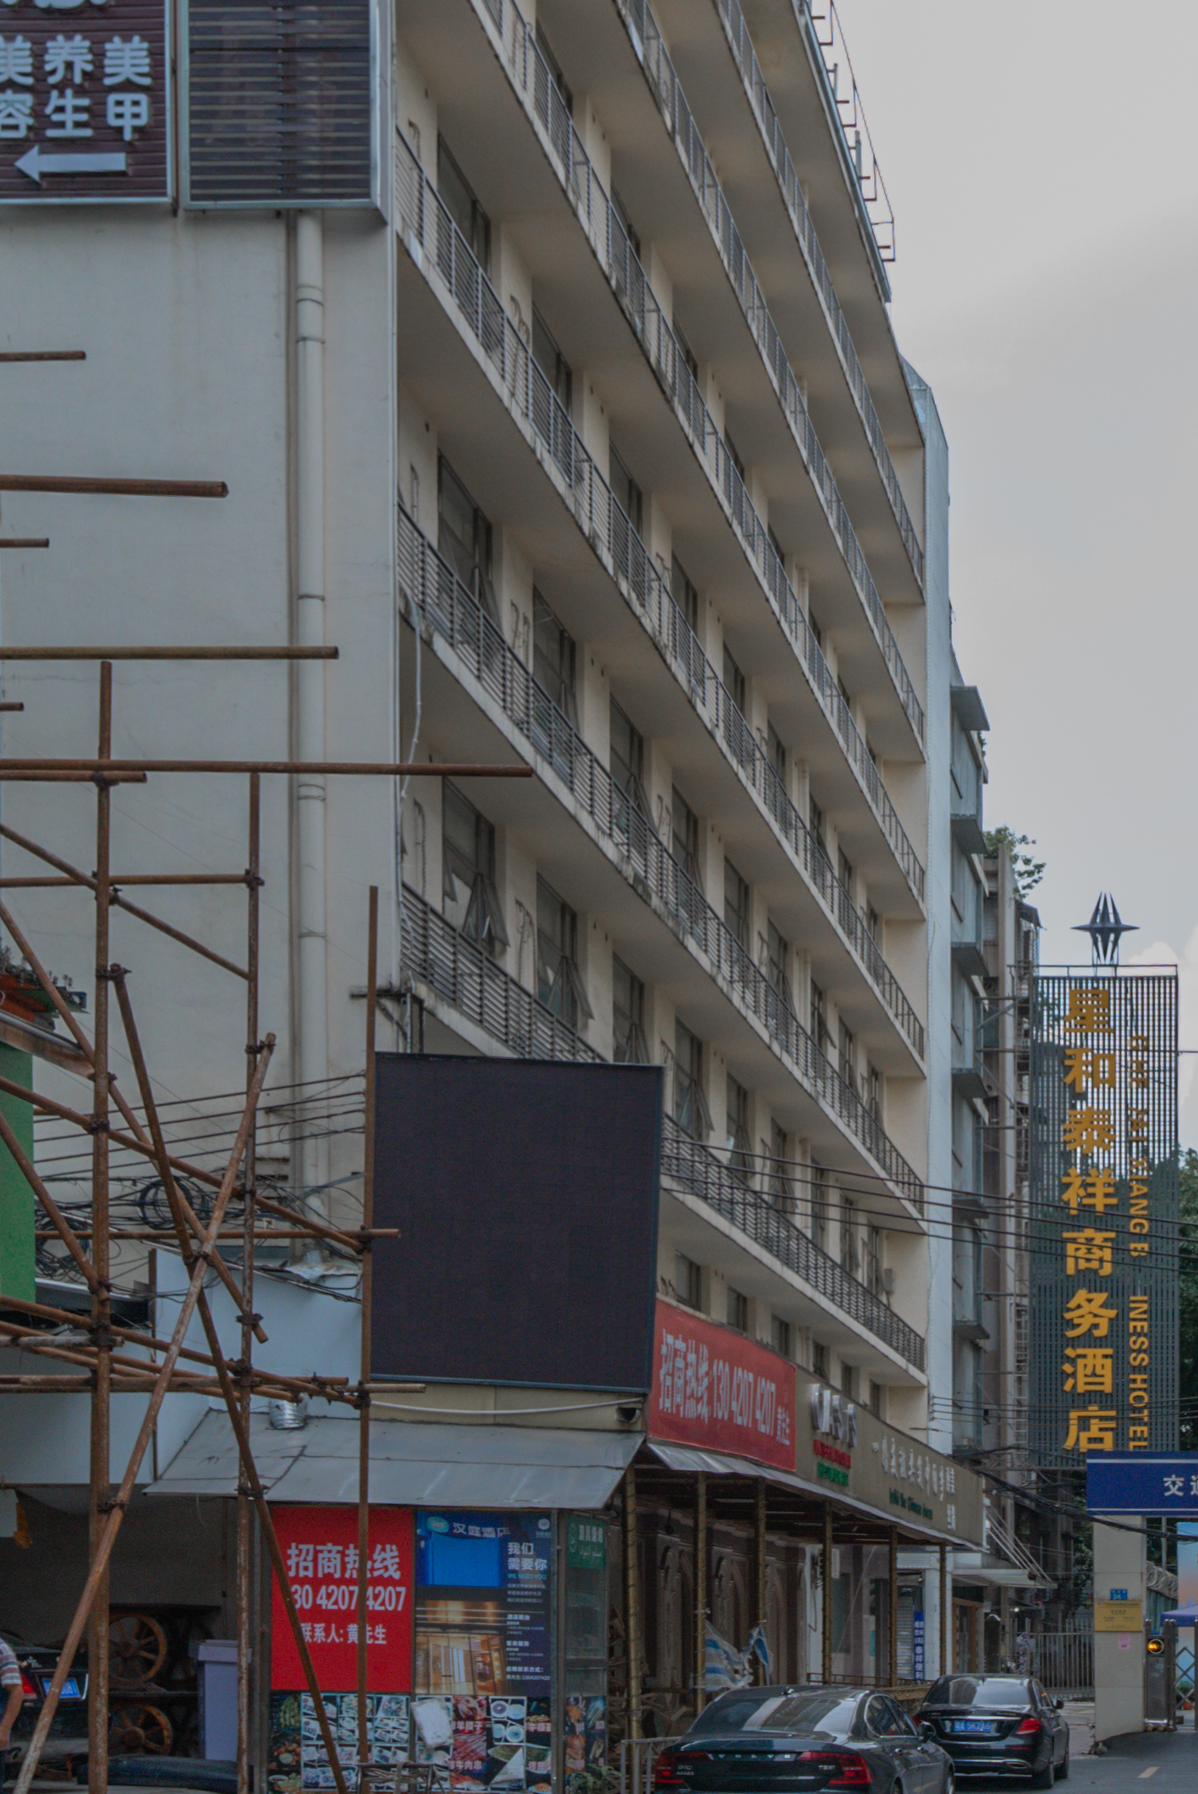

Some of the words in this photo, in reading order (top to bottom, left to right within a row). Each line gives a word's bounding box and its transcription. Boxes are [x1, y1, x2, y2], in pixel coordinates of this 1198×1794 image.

[44, 35, 94, 138] 养生
[103, 35, 153, 142] 美甲
[1061, 989, 1119, 1452] 星和泰祥商务酒店
[286, 1542, 401, 1581] 招商热线
[290, 1584, 313, 1610] 30
[316, 1585, 359, 1610] 4207
